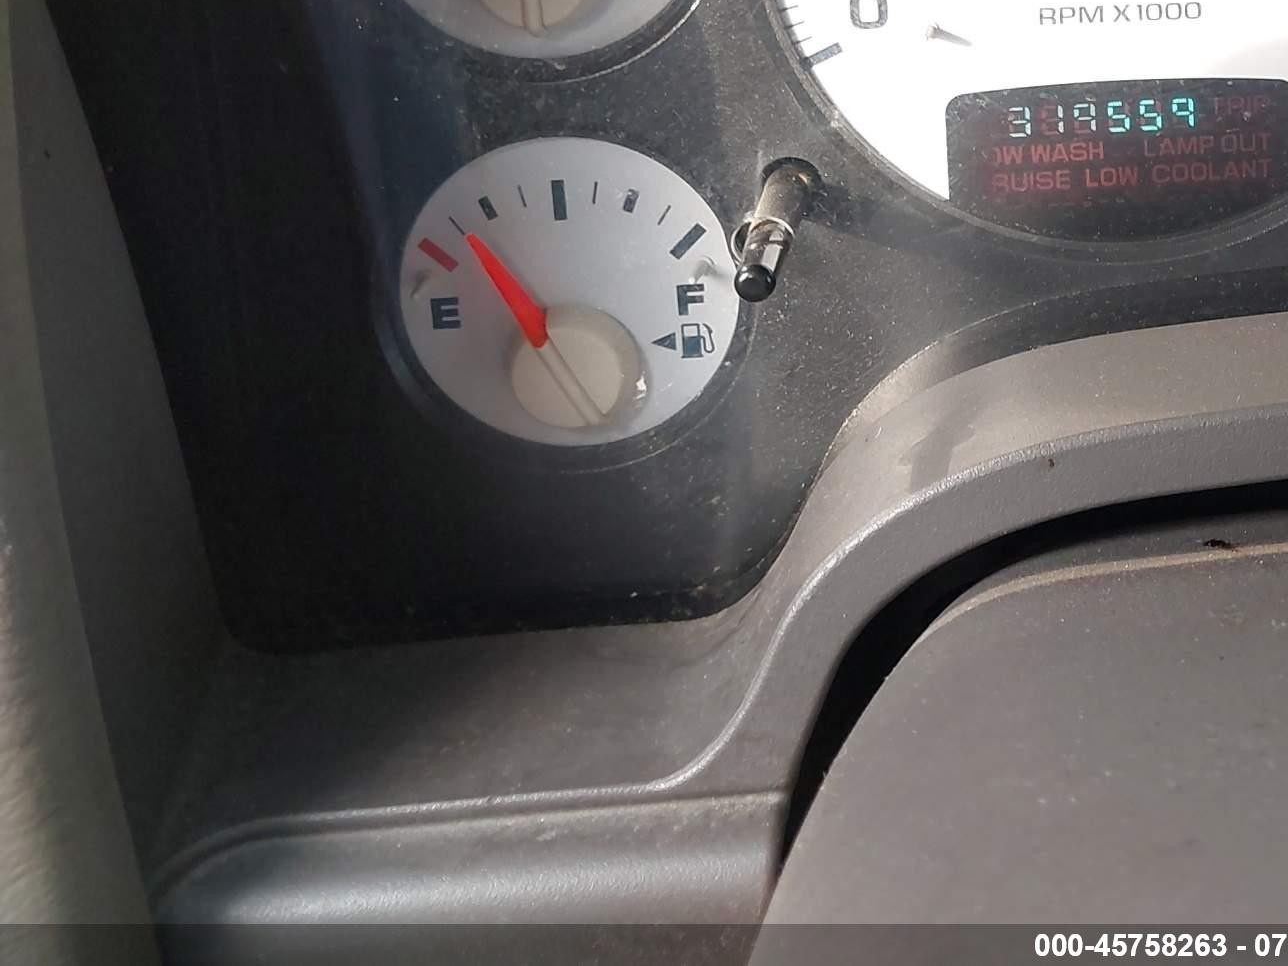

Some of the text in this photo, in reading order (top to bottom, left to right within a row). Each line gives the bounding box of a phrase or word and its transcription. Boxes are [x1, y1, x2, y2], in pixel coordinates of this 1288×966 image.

[1040, 6, 1103, 25] RPM
[1031, 141, 1104, 164] WASH
[1144, 132, 1272, 158] LAMP OUT
[1086, 158, 1272, 188] LOW COOLANT
[430, 297, 461, 329] E
[676, 284, 705, 315] F
